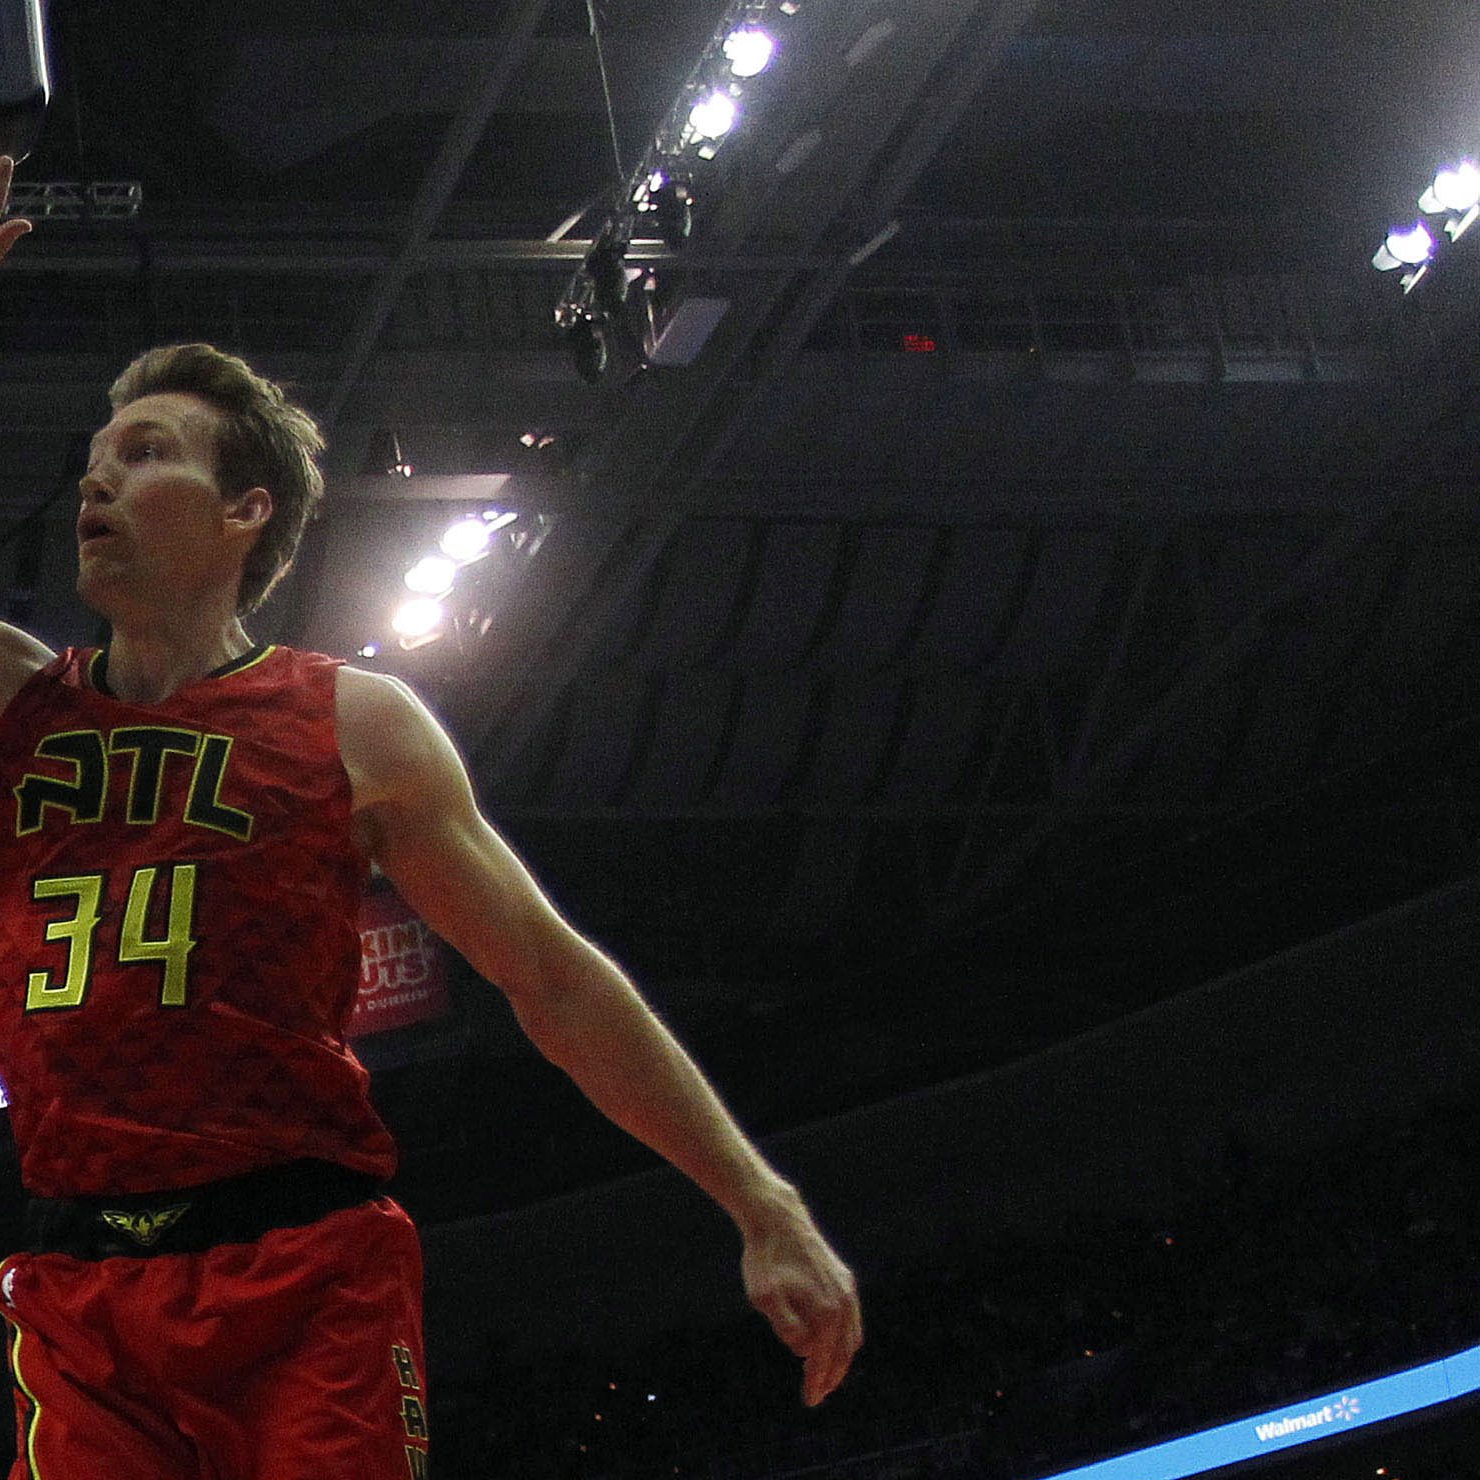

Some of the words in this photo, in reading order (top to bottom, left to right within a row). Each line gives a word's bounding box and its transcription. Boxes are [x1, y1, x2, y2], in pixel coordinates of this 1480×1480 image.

[14, 726, 254, 842] ATL
[25, 864, 197, 1012] 34
[1254, 1406, 1333, 1442] Walmart
